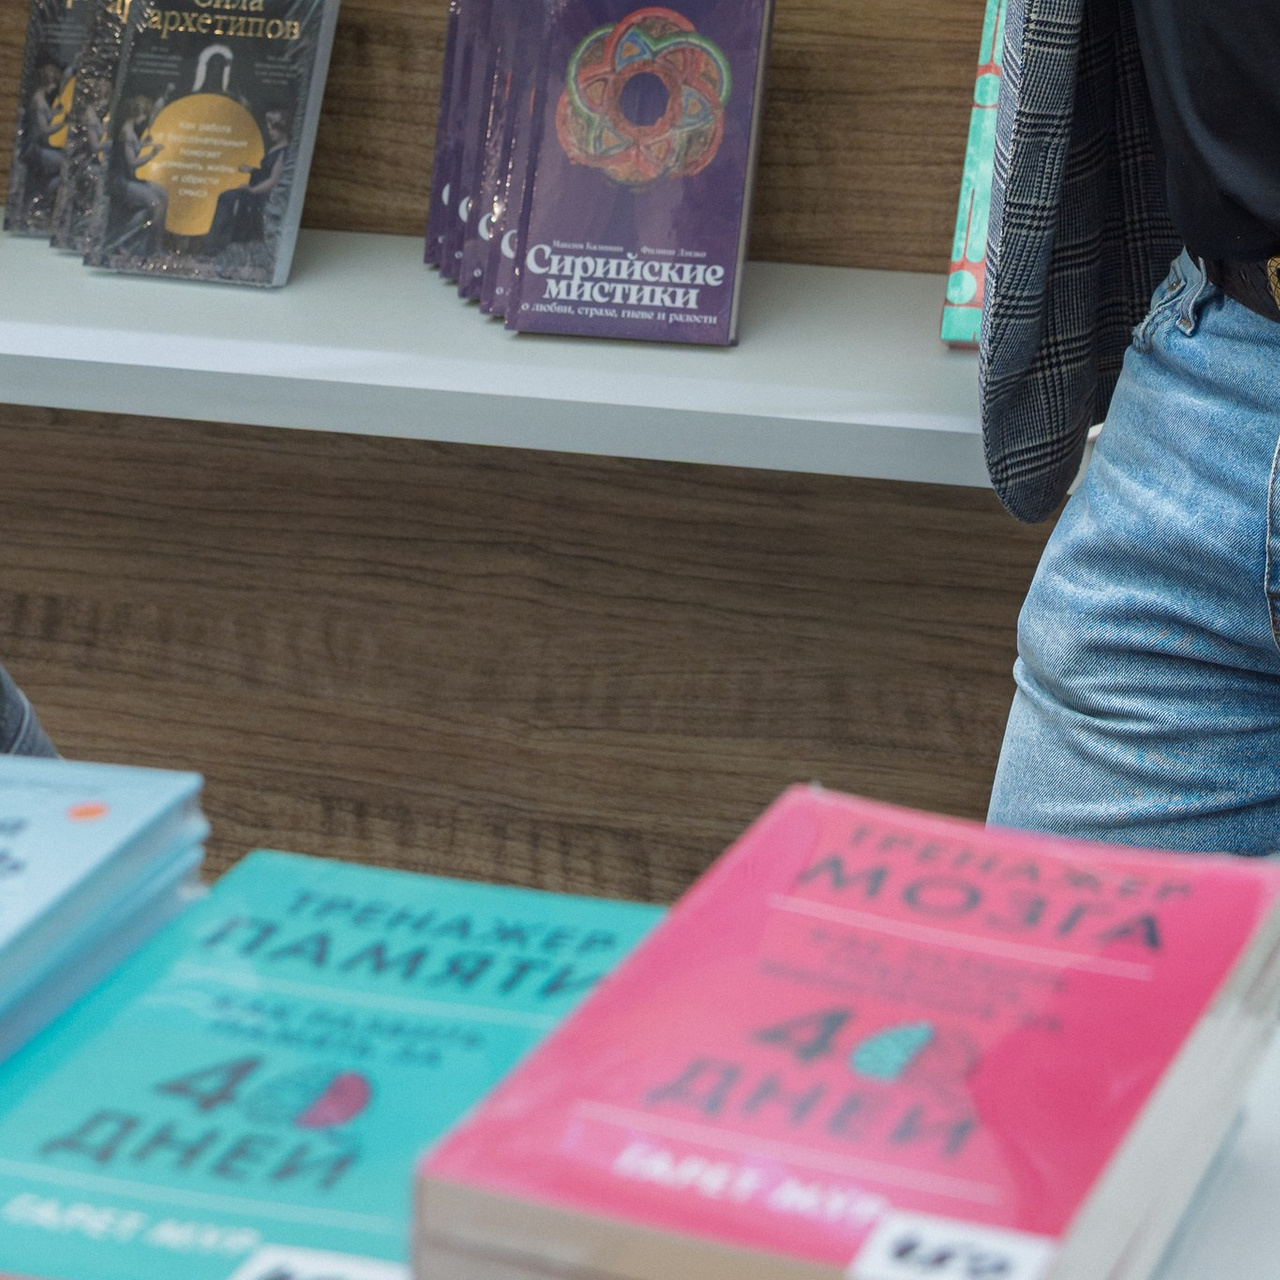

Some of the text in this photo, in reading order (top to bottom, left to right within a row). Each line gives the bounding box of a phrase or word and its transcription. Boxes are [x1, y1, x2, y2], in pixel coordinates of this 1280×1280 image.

[148, 8, 300, 40] архетипов
[526, 244, 725, 286] Сирийские
[521, 303, 529, 311] о
[657, 312, 665, 321] и
[668, 313, 718, 325] радости
[543, 278, 700, 309] мистики
[852, 824, 1191, 901] ТРЕНАЖЕР
[288, 890, 617, 952] ТРЕНАЖЕР
[795, 854, 1161, 952] МОЗГА
[202, 915, 606, 998] ПАМЯТИ
